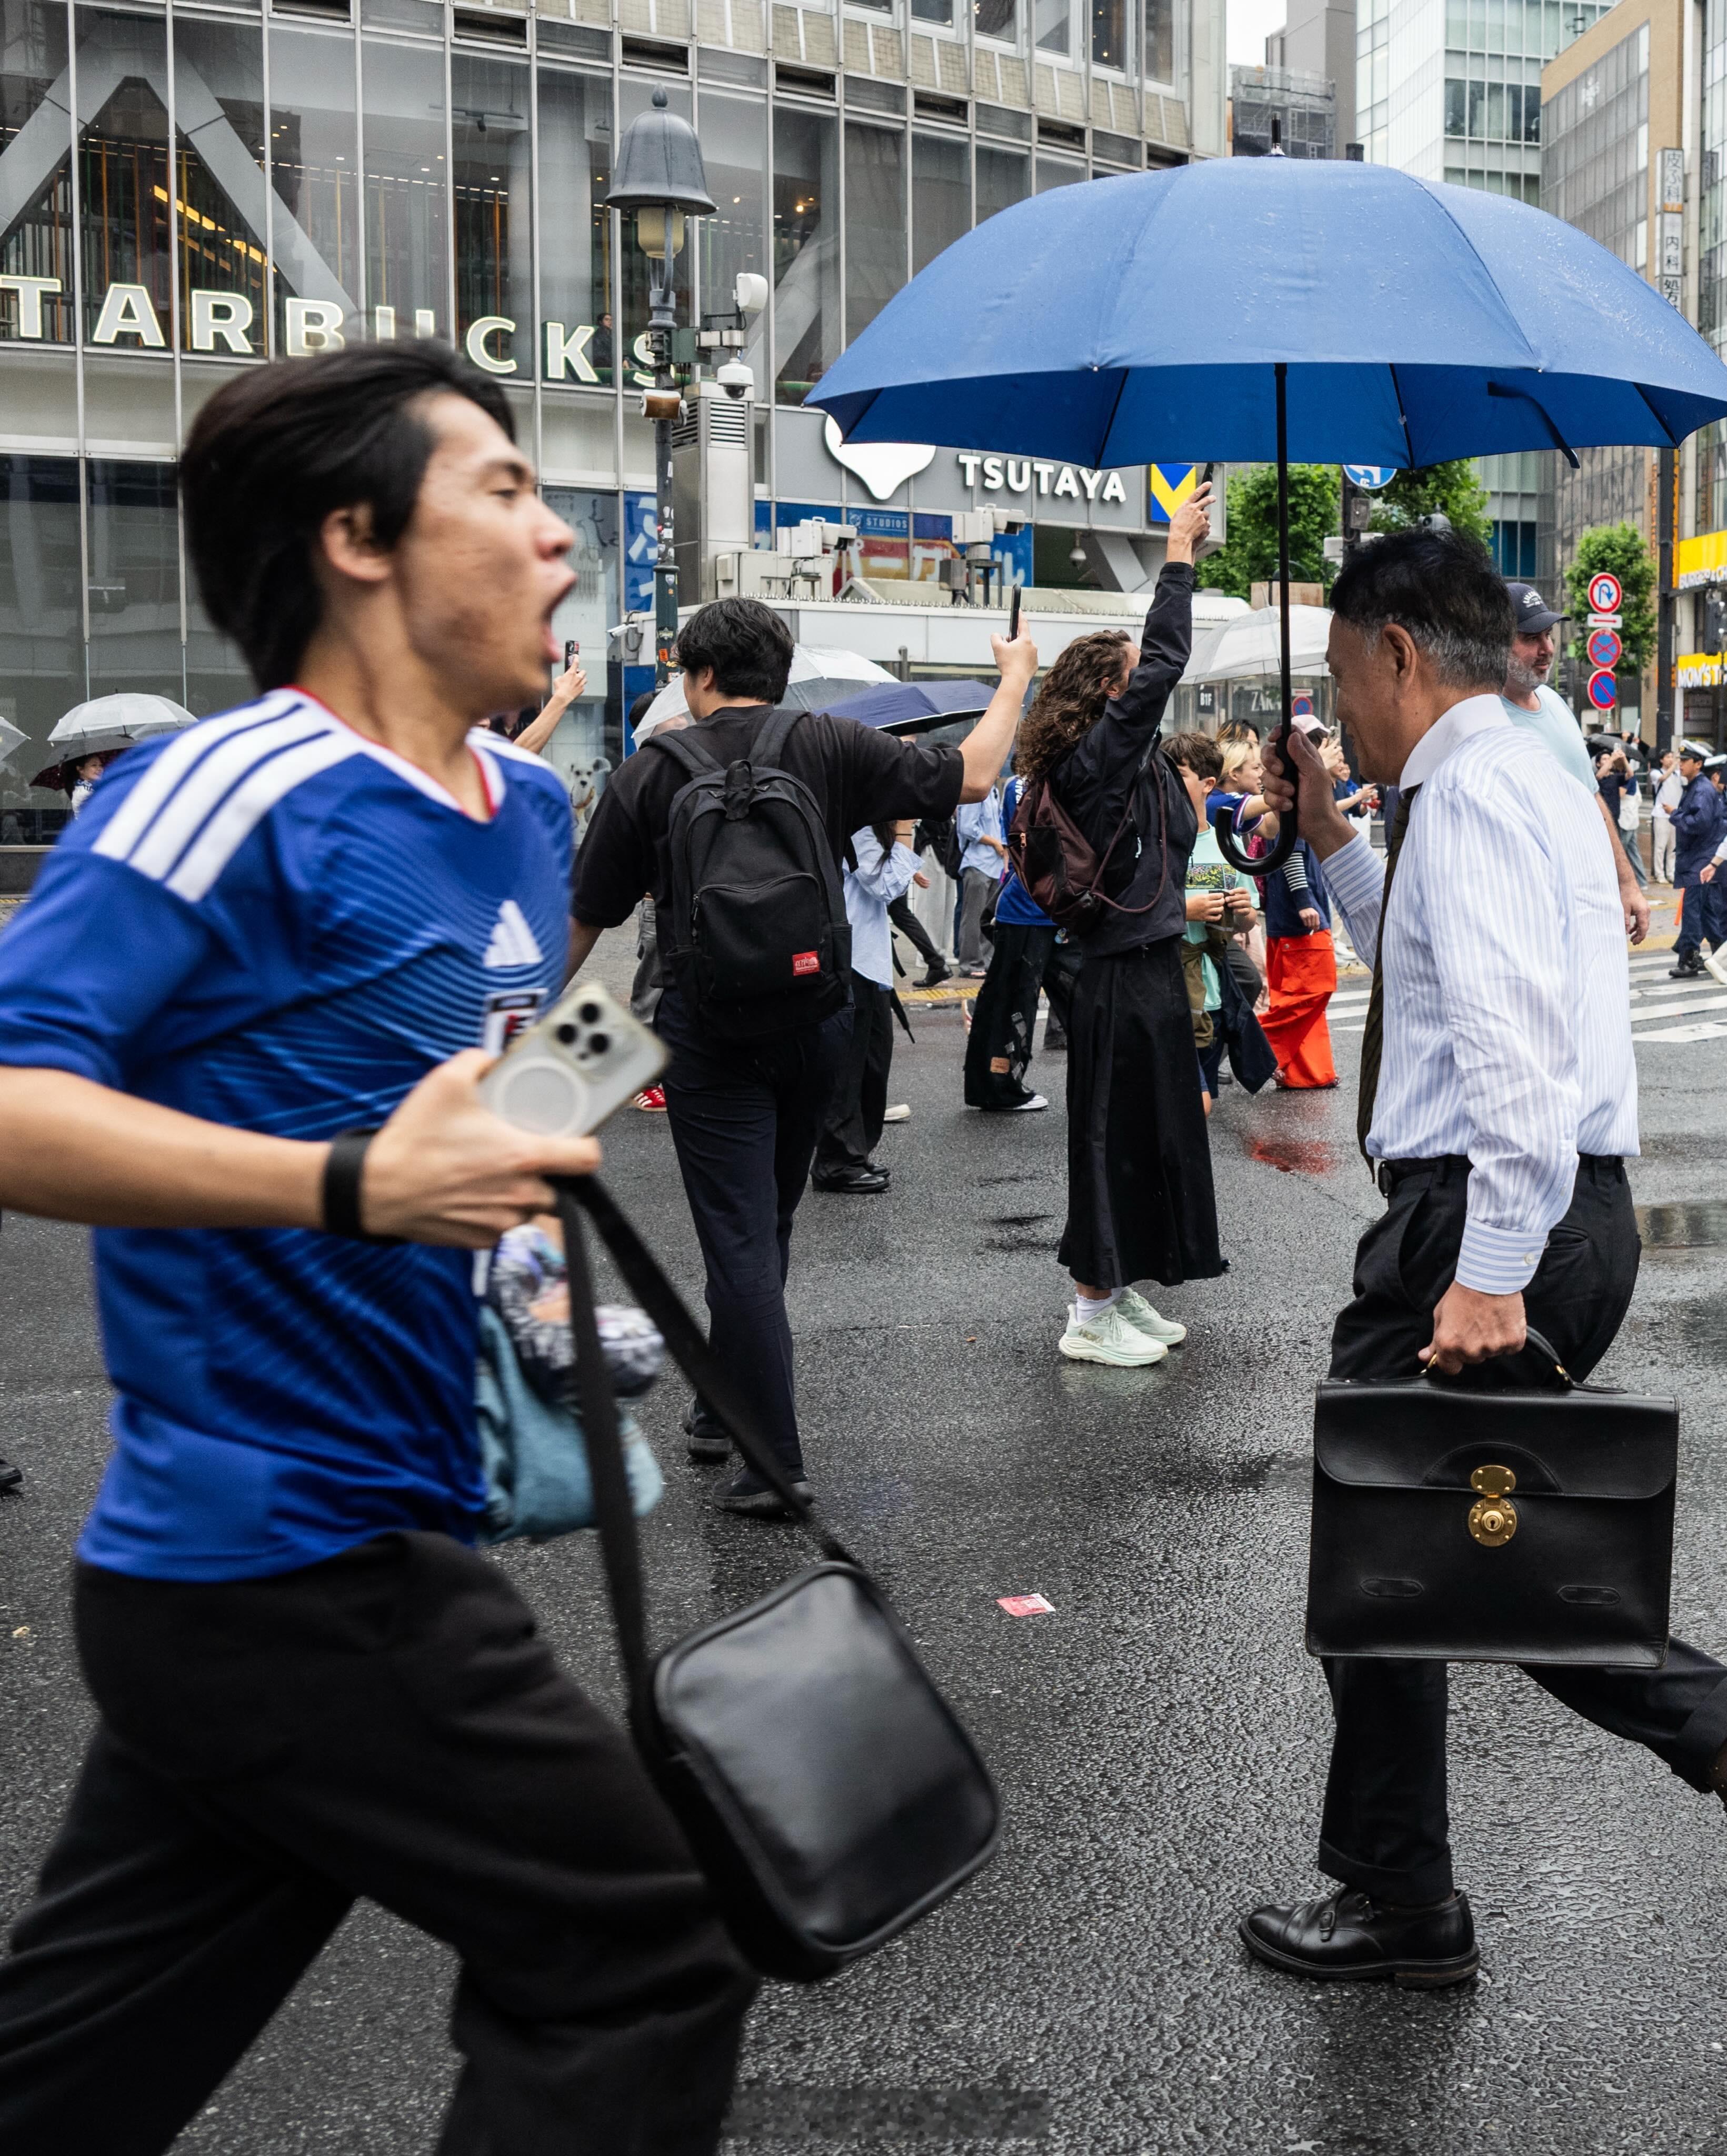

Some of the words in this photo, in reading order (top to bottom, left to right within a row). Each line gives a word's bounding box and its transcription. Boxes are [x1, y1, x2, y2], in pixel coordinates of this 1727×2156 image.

[1665, 236, 1680, 270] 内科
[1664, 278, 1680, 310] 処方
[958, 454, 1127, 503] TSUTAYA
[866, 517, 908, 530] STUDIOS
[1678, 663, 1711, 688] MOM'S
[1200, 692, 1212, 706] B1F
